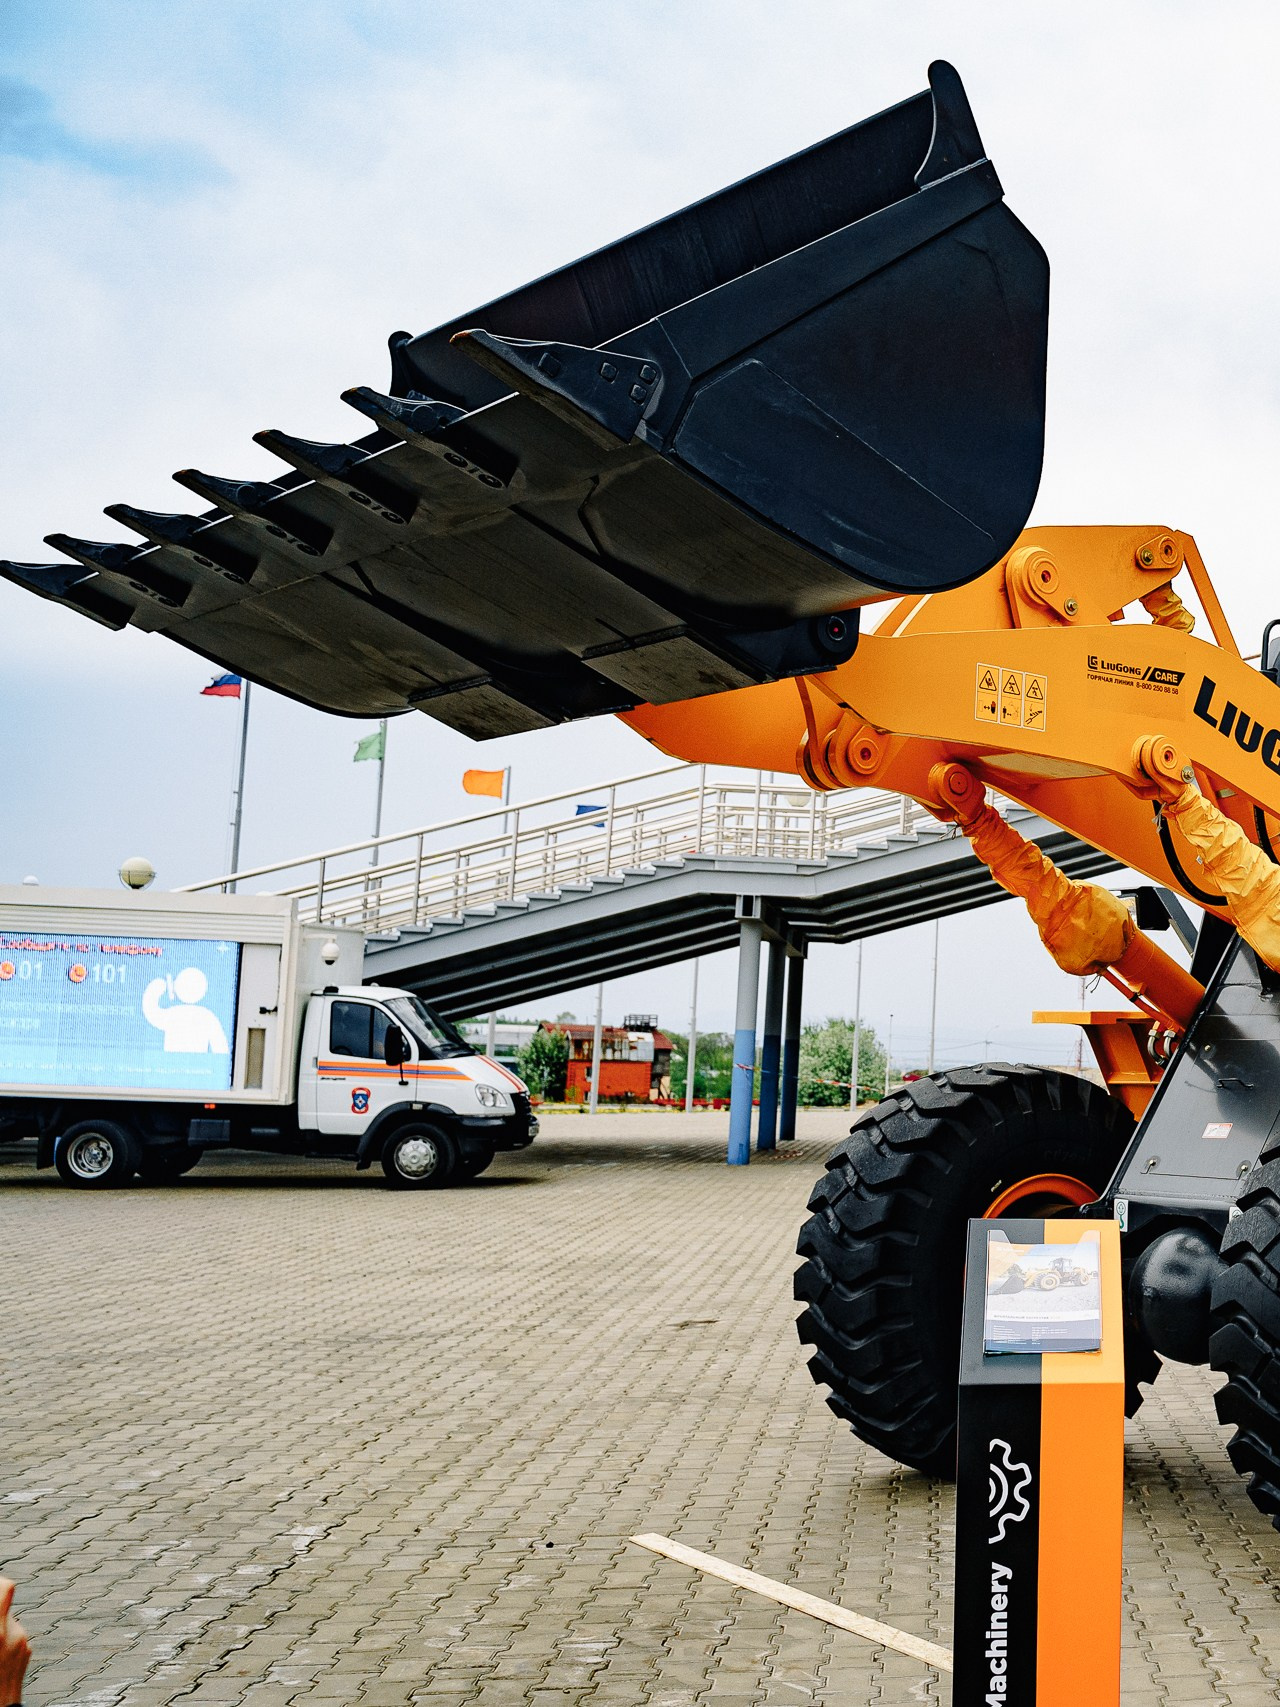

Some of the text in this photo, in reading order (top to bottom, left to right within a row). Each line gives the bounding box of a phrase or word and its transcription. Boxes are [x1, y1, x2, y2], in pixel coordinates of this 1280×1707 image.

[1087, 673, 1114, 684] ГОРЯЧАЯ
[1114, 678, 1134, 687] ЛИНИЯ
[1136, 681, 1152, 691] 8-800
[1153, 684, 1163, 693] 250
[1154, 670, 1179, 683] CARE
[18, 960, 127, 984] 01 101
